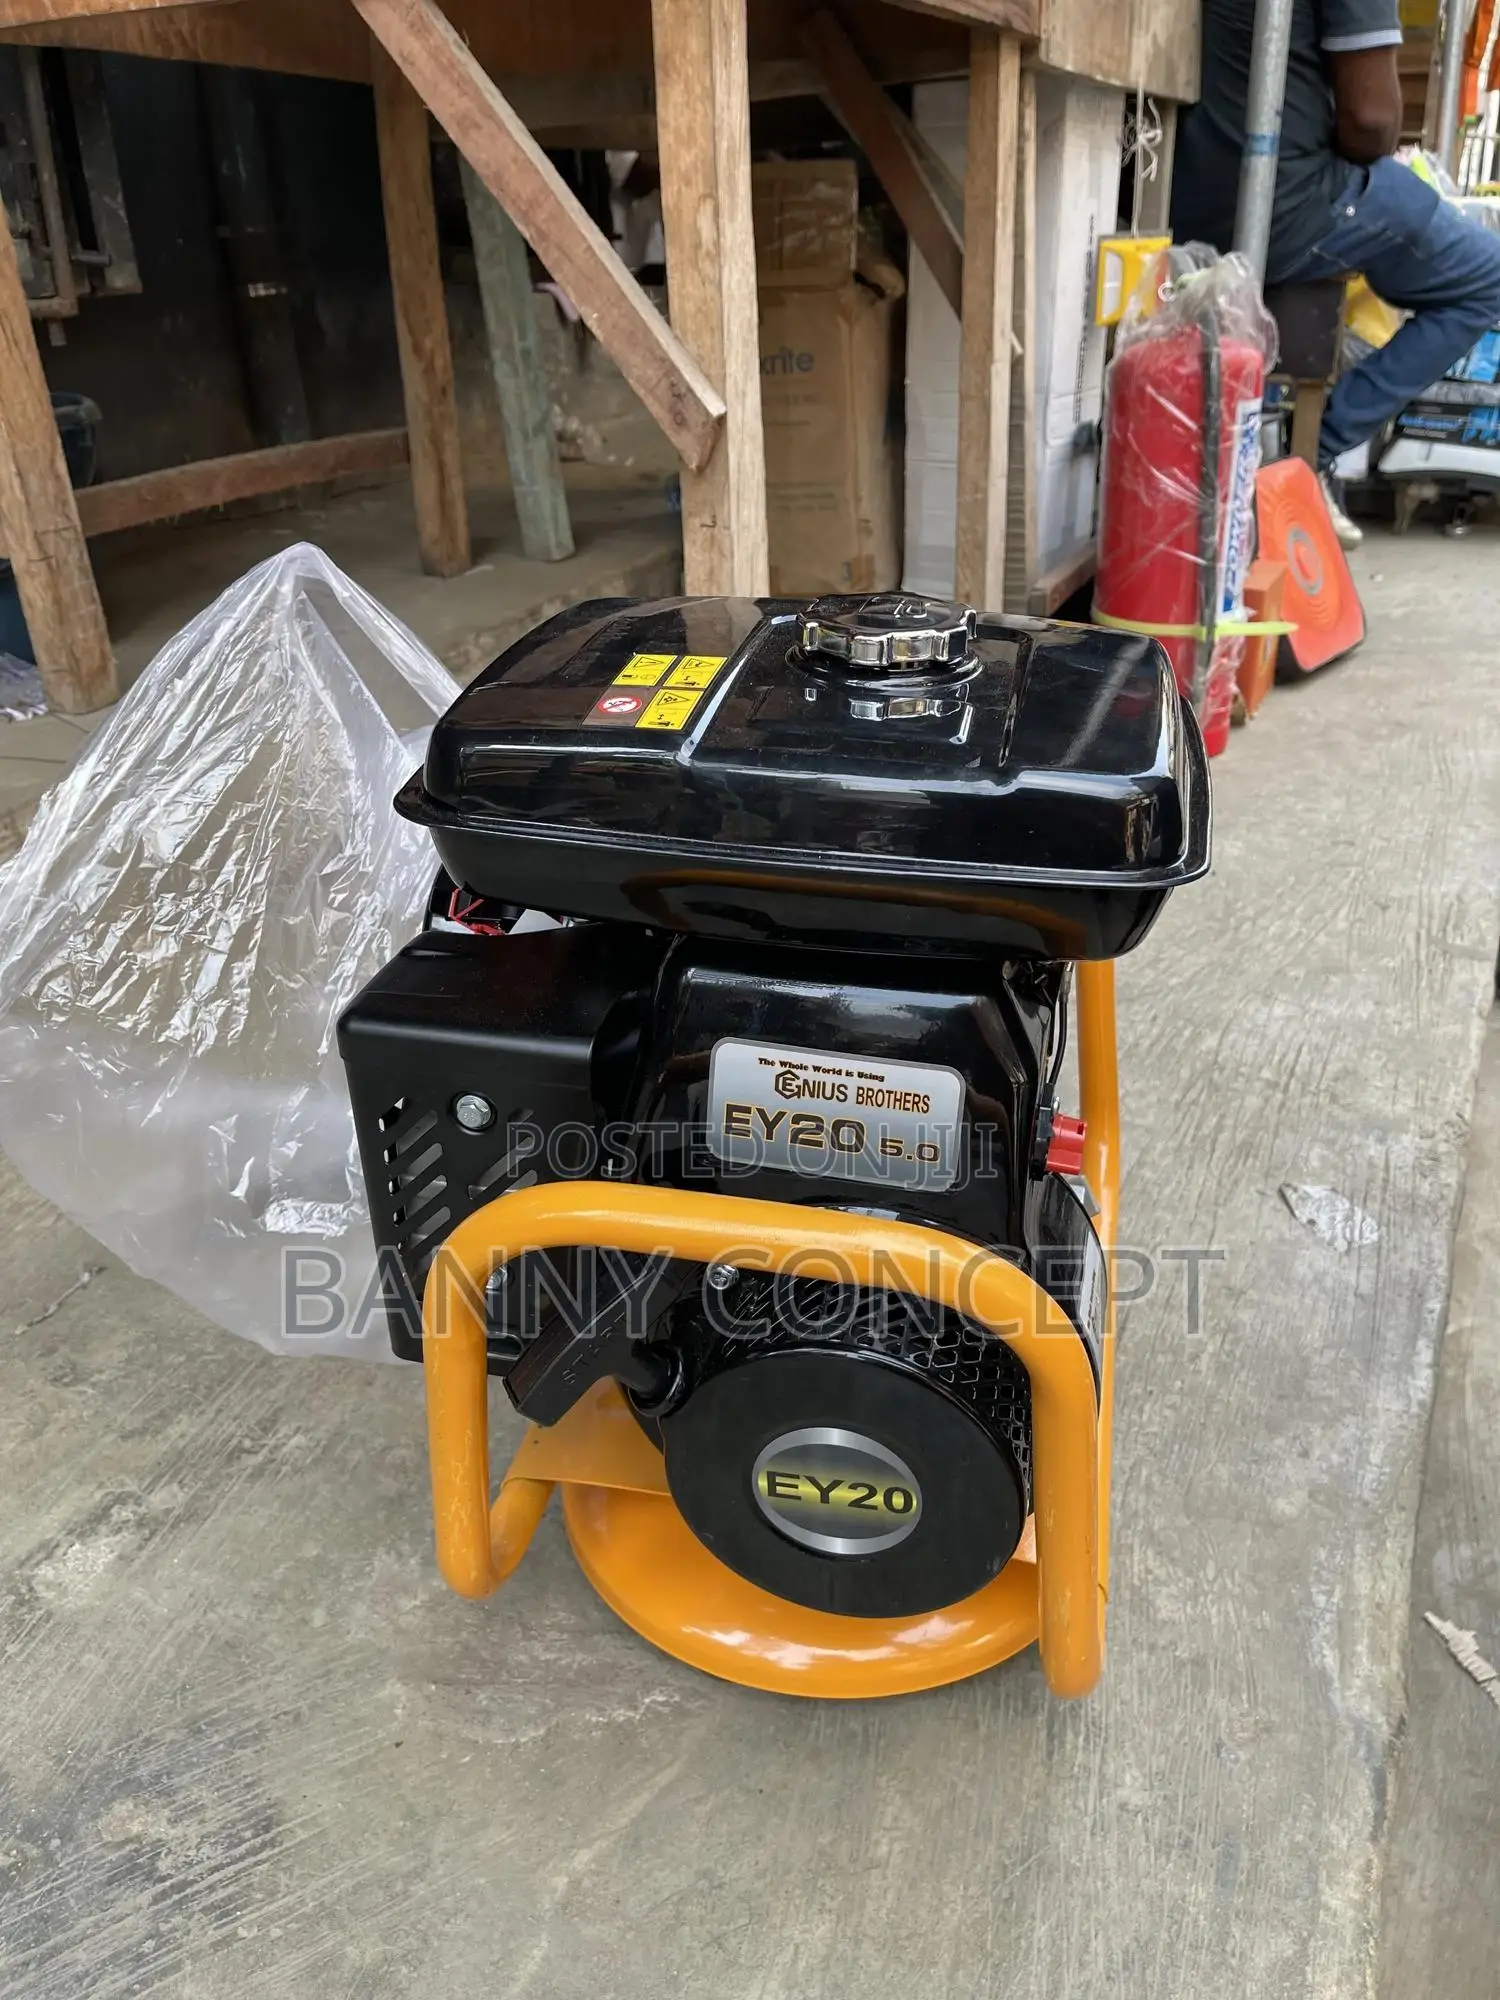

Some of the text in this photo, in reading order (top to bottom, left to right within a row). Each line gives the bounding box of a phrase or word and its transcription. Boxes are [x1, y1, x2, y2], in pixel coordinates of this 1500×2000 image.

[758, 1057, 775, 1067] The
[779, 1060, 808, 1071] Whole
[812, 1065, 842, 1076] World
[857, 1071, 885, 1082] Using
[856, 1086, 931, 1114] BROTHERS
[723, 1102, 941, 1163] EY20 5.0
[766, 1470, 914, 1514] EY20
